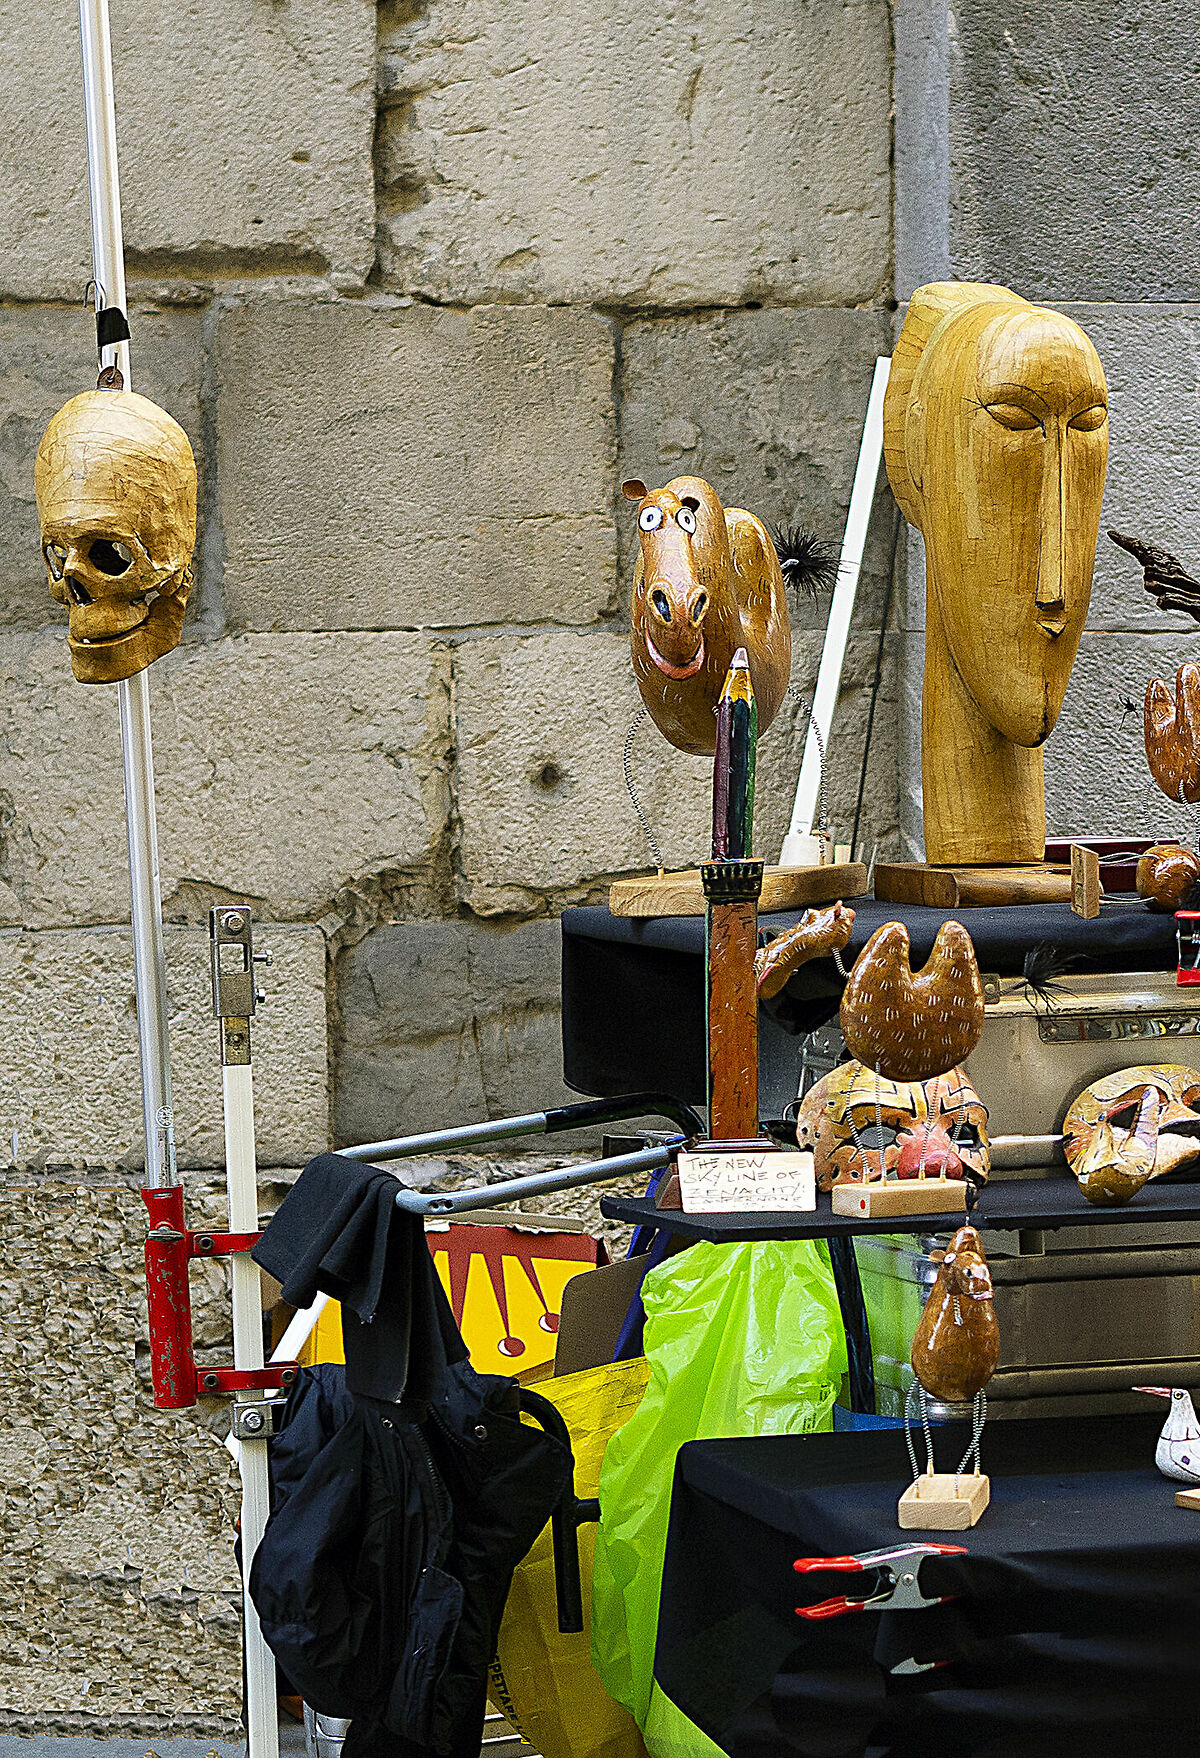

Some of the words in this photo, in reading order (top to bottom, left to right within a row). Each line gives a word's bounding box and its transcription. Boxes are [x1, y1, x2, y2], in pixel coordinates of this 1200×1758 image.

[686, 1156, 720, 1171] THE
[725, 1154, 767, 1170] NEW
[775, 1170, 801, 1180] OF
